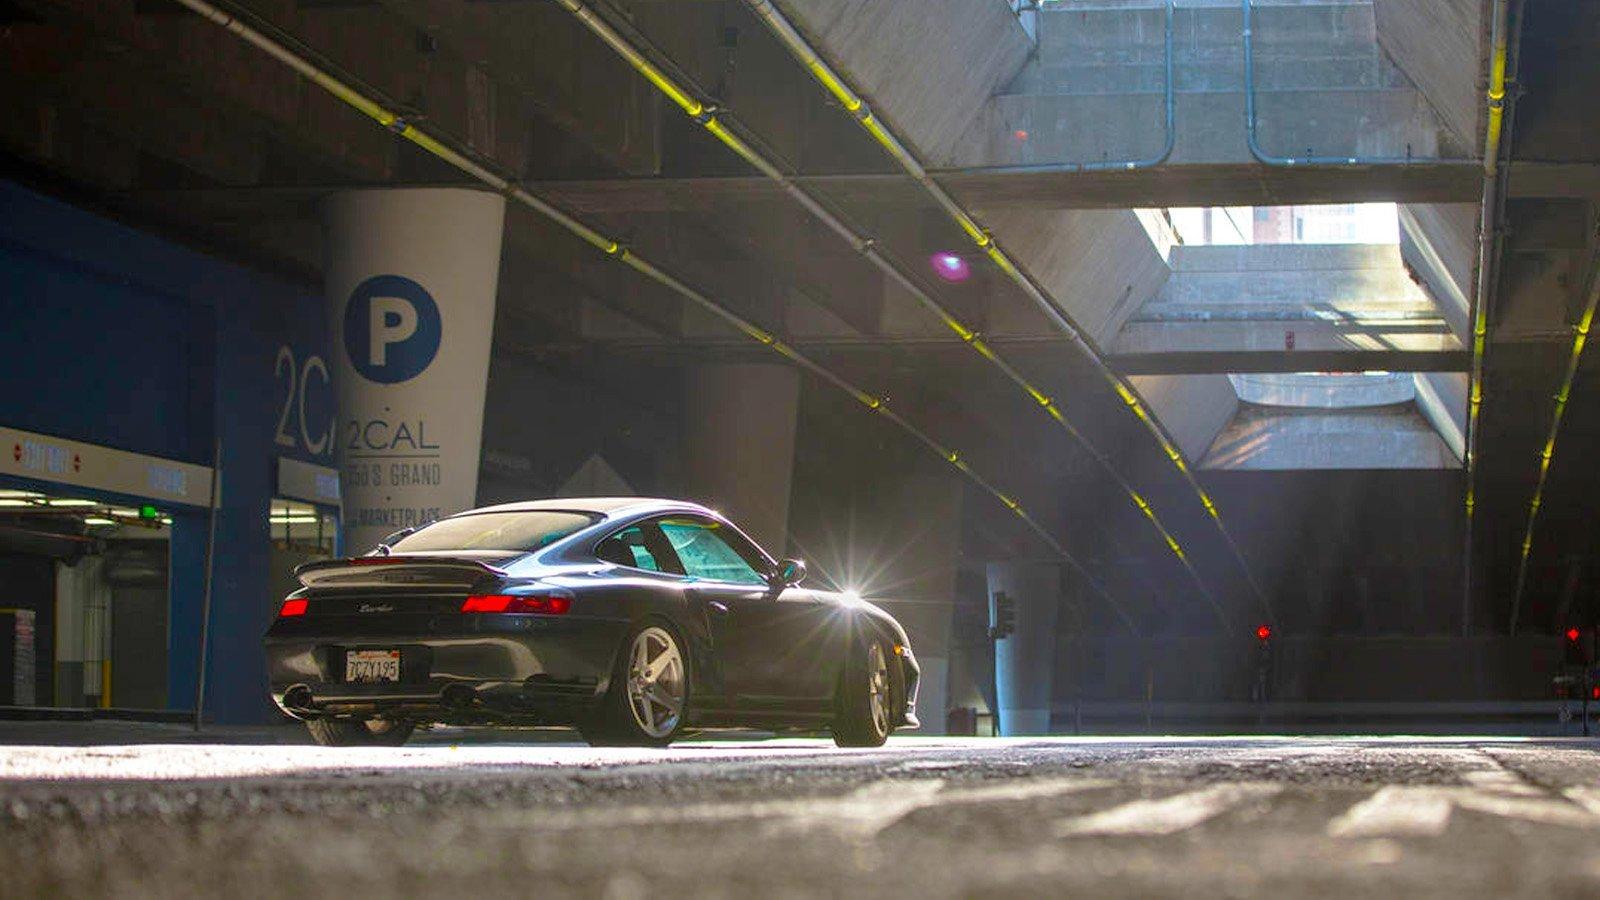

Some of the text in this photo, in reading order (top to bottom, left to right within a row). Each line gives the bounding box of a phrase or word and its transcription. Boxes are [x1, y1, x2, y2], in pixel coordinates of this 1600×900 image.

[369, 296, 419, 366] P
[275, 345, 336, 454] 2C
[348, 420, 440, 450] 2CAL
[391, 462, 440, 486] GRAND
